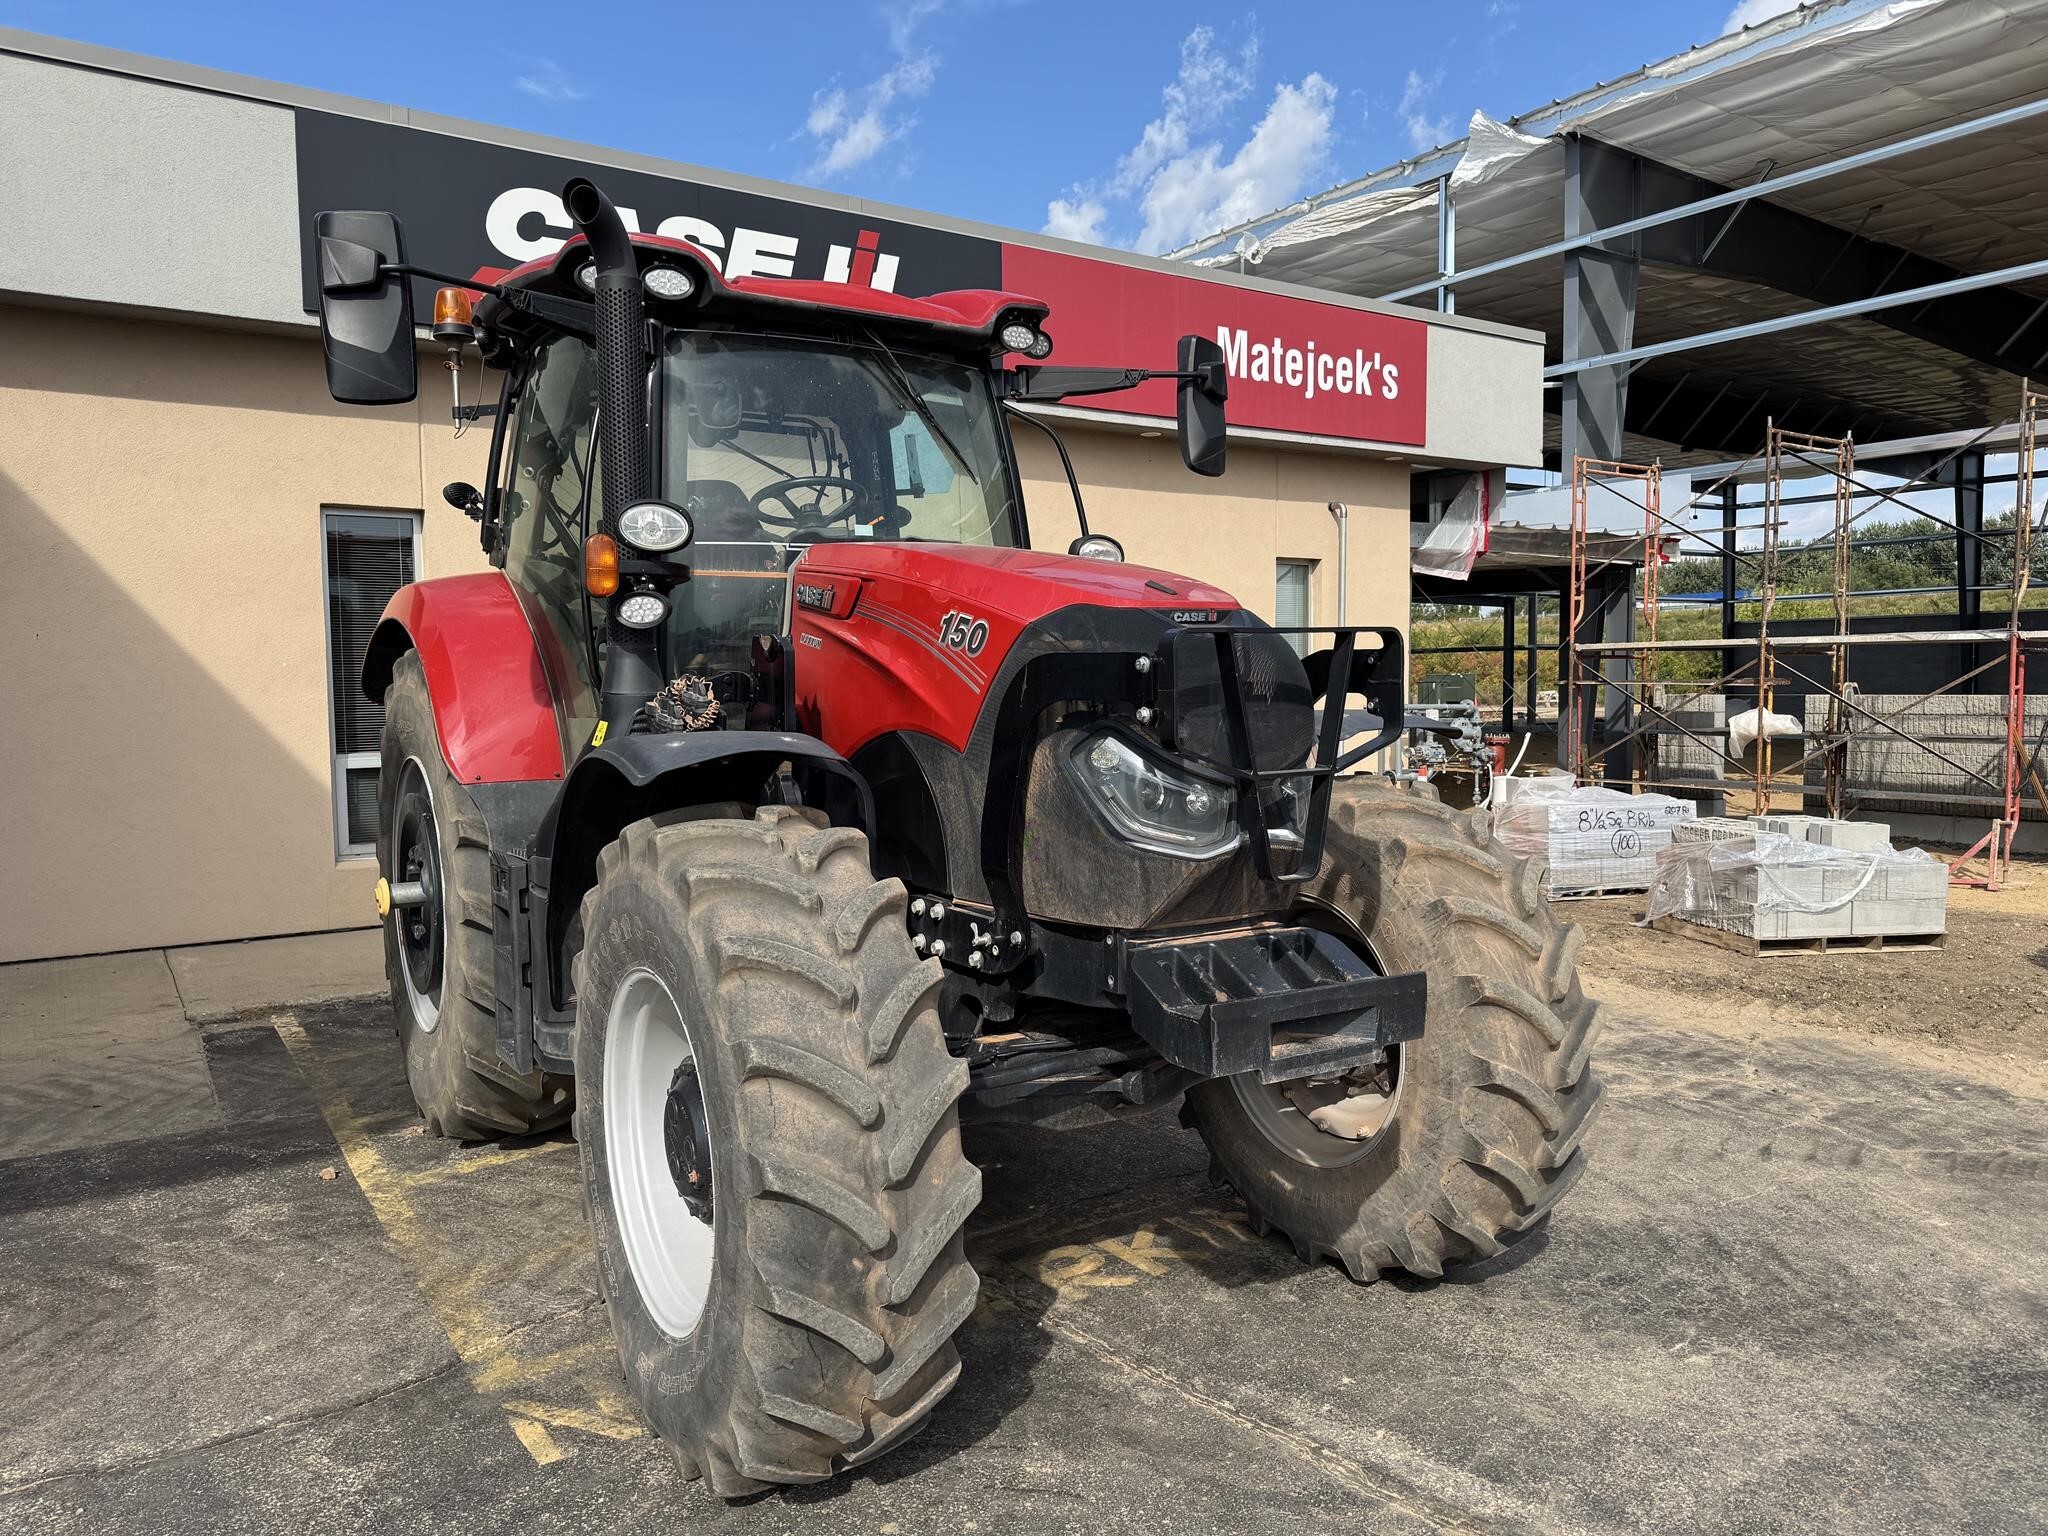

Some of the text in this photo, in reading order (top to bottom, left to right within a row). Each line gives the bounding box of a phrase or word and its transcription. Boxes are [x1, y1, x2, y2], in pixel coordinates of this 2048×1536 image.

[486, 187, 799, 279] CSE
[1217, 325, 1399, 400] Matejcek's
[797, 584, 822, 606] CASE
[938, 609, 990, 658] 150
[1174, 612, 1206, 622] CASE
[1617, 833, 1636, 853] 100
